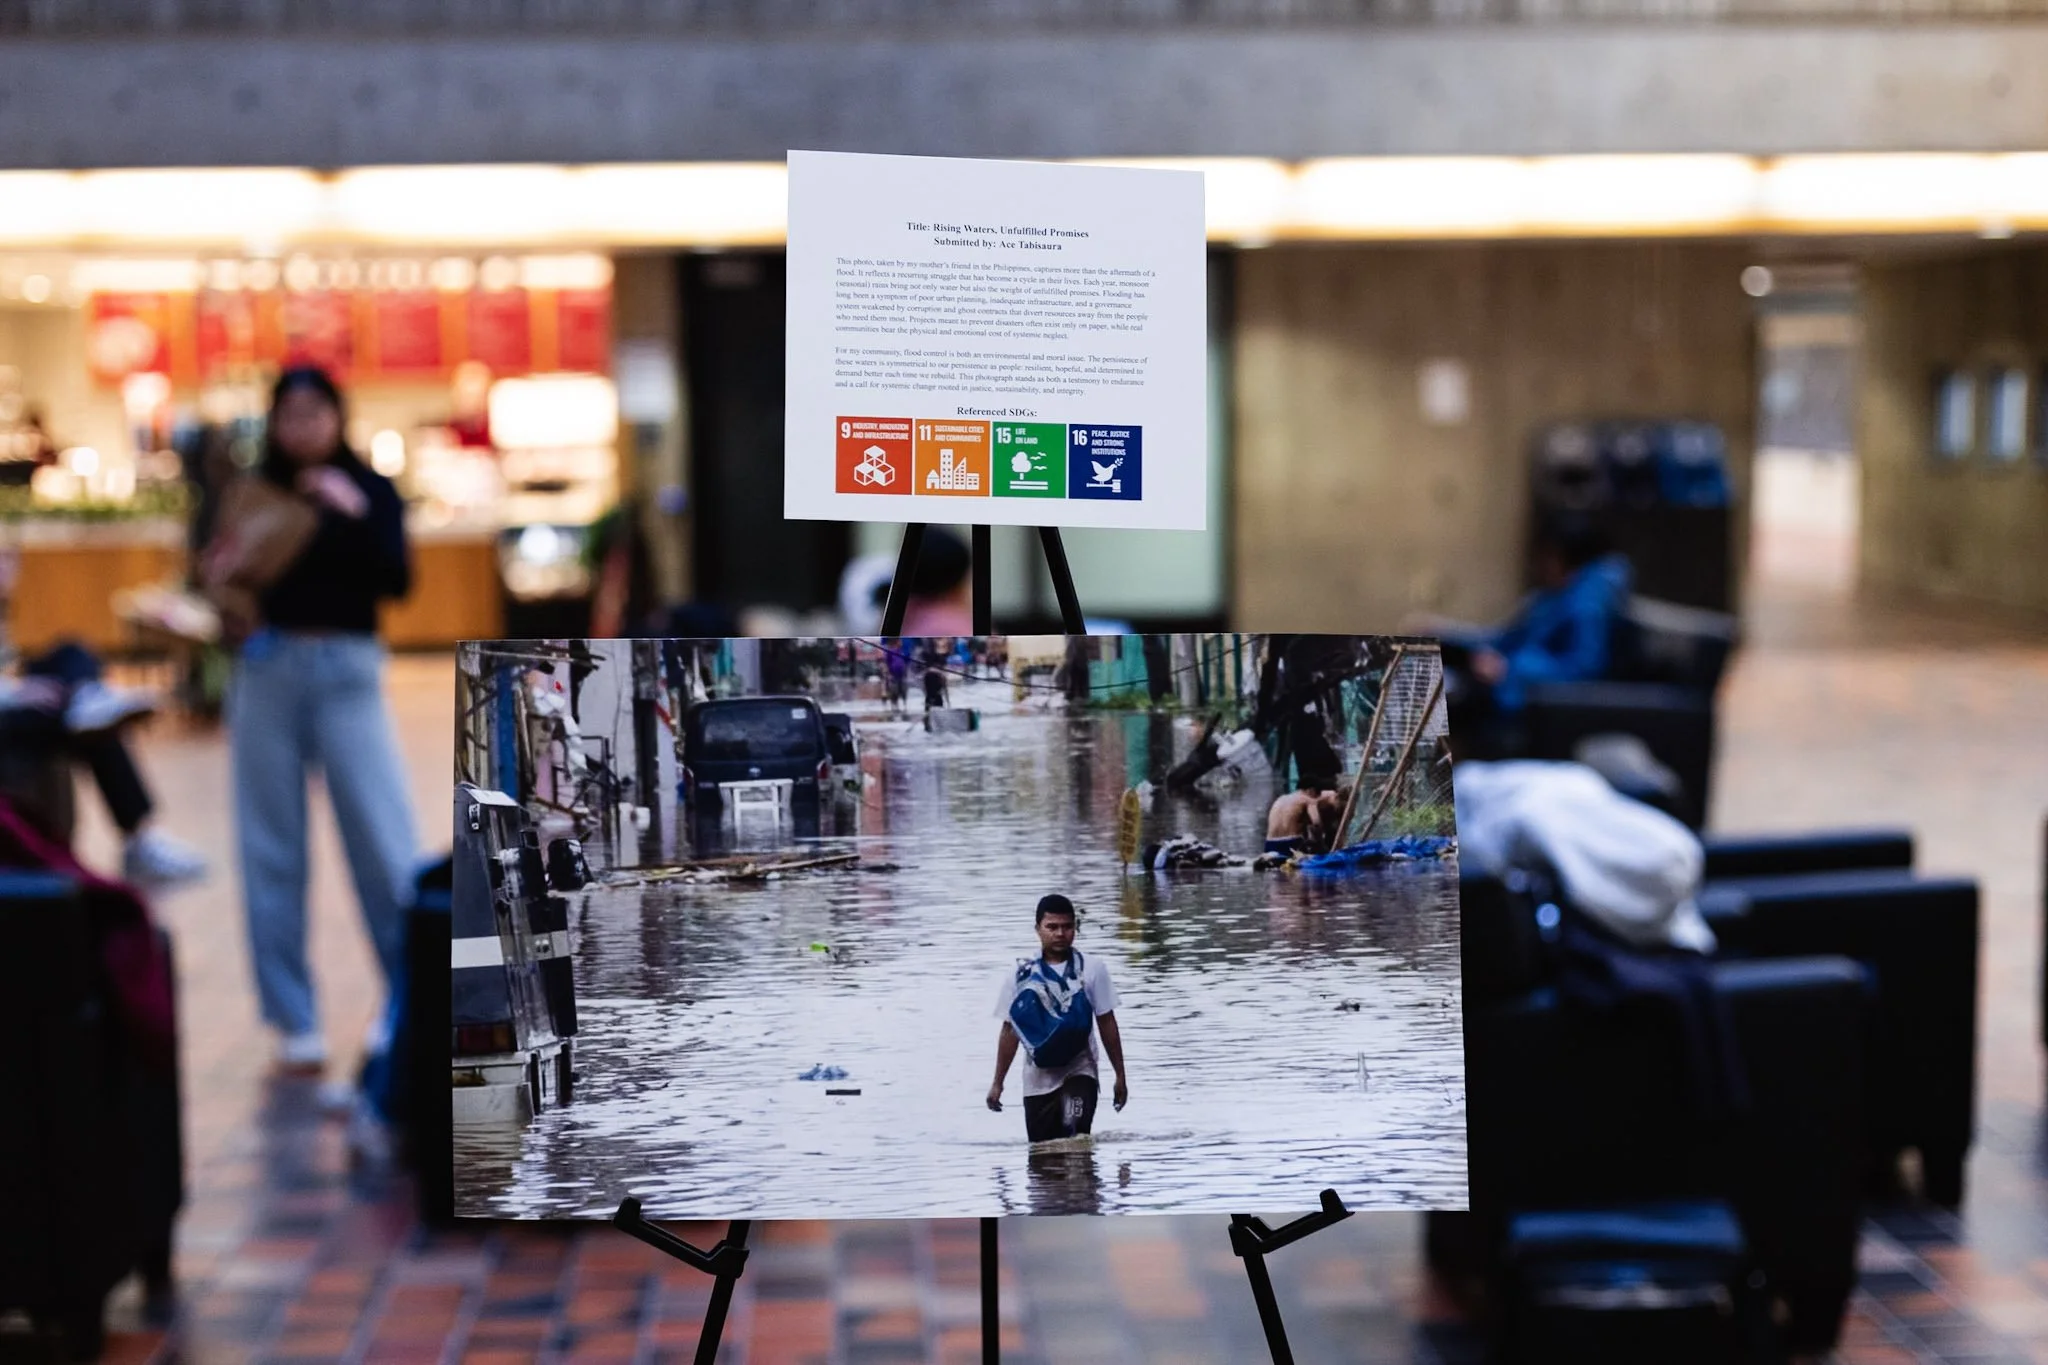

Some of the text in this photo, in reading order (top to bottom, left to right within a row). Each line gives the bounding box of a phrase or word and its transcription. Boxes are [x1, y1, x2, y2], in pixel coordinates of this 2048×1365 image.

[908, 222, 1089, 238] Title: Rising Waters, Unfulfilled Promises
[934, 238, 980, 247] Submitted
[982, 240, 996, 250] by:
[1019, 242, 1062, 251] Tabisaura
[853, 257, 875, 268] photo,
[876, 258, 895, 266] taken
[896, 259, 905, 269] by
[951, 262, 972, 270] friend
[865, 269, 890, 277] reflects
[929, 272, 957, 282] struggle
[986, 274, 1012, 282] become
[1019, 275, 1037, 285] cycle
[1101, 280, 1118, 288] year,
[836, 279, 871, 290] (seasonal)
[890, 281, 909, 291] bring
[922, 282, 938, 292] only
[1000, 286, 1023, 296] weight
[1033, 287, 1068, 296] unfulfilled
[1103, 290, 1133, 300] Flooding
[836, 290, 851, 300] long
[918, 295, 934, 303] poor
[957, 295, 988, 305] planning,
[990, 296, 1026, 307] inadequate
[1027, 298, 1074, 309] infrastructure,
[1094, 302, 1132, 311] governance
[909, 315, 936, 325] Projects
[938, 316, 959, 324] meant
[968, 317, 994, 327] prevent
[995, 318, 1025, 327] disasters
[1062, 321, 1077, 330] only
[1088, 324, 1109, 332] paper,
[923, 349, 948, 357] control
[983, 351, 1031, 360] environmental
[835, 368, 863, 376] demand
[864, 369, 883, 377] better
[975, 373, 1014, 383] photograph
[1068, 376, 1100, 386] testimony
[1111, 377, 1144, 386] endurance
[881, 381, 911, 391] systemic
[912, 382, 936, 392] change
[969, 384, 994, 394] justice,
[995, 385, 1041, 396] sustainability,
[957, 407, 1007, 416] Referenced
[840, 422, 851, 438] 9
[918, 424, 932, 441] 11
[996, 427, 1012, 444] 15
[1072, 429, 1088, 446] 16
[1091, 430, 1130, 438] PEACE, JUSTICE
[1103, 439, 1124, 447] STRONG
